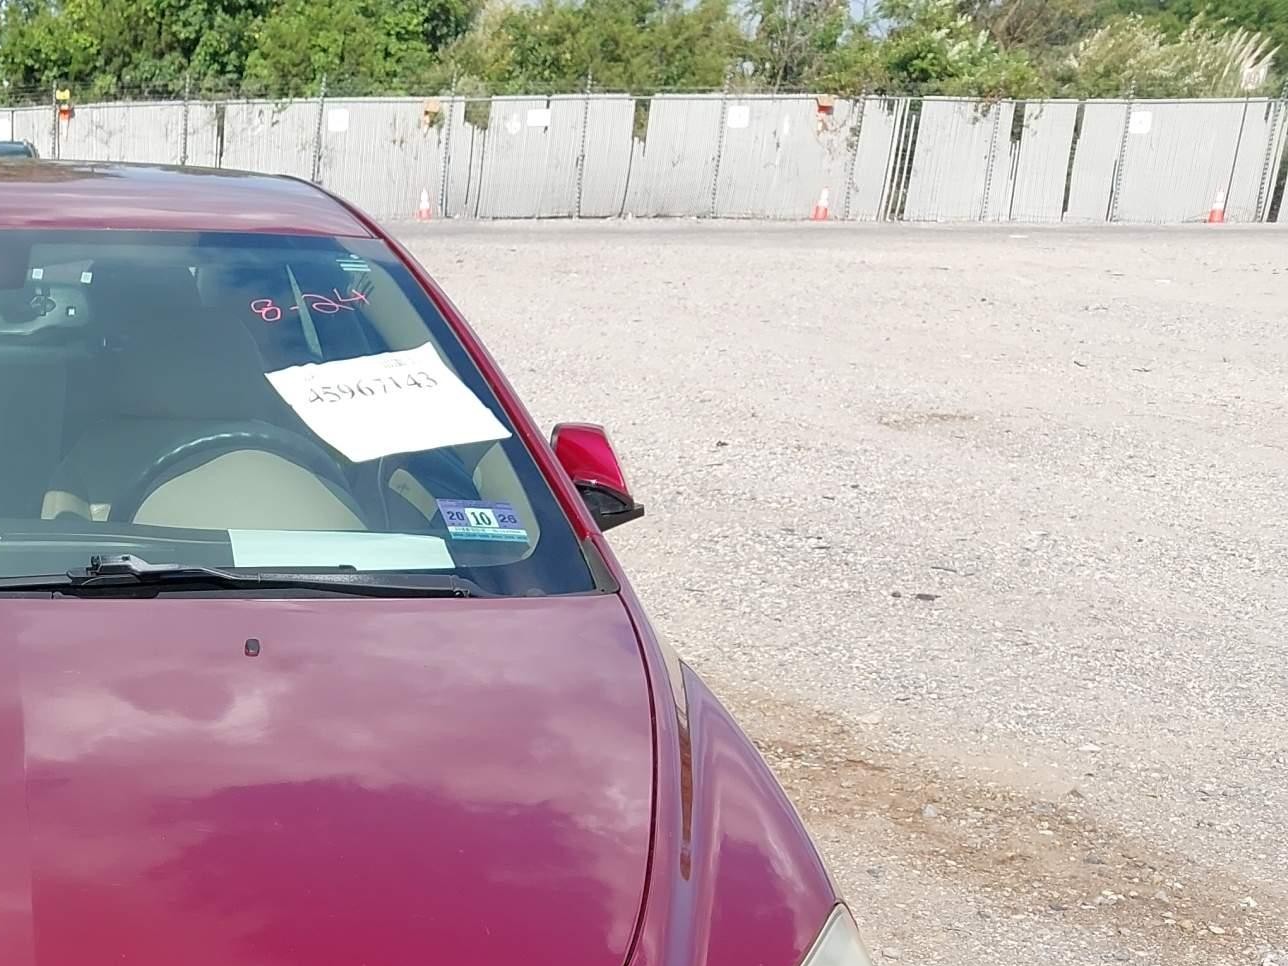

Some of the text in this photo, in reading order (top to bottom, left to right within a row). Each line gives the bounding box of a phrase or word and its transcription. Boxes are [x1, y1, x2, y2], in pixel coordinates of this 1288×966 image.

[250, 288, 371, 322] 8-24
[308, 371, 439, 403] 45967143
[446, 510, 518, 526] 20 10 26
